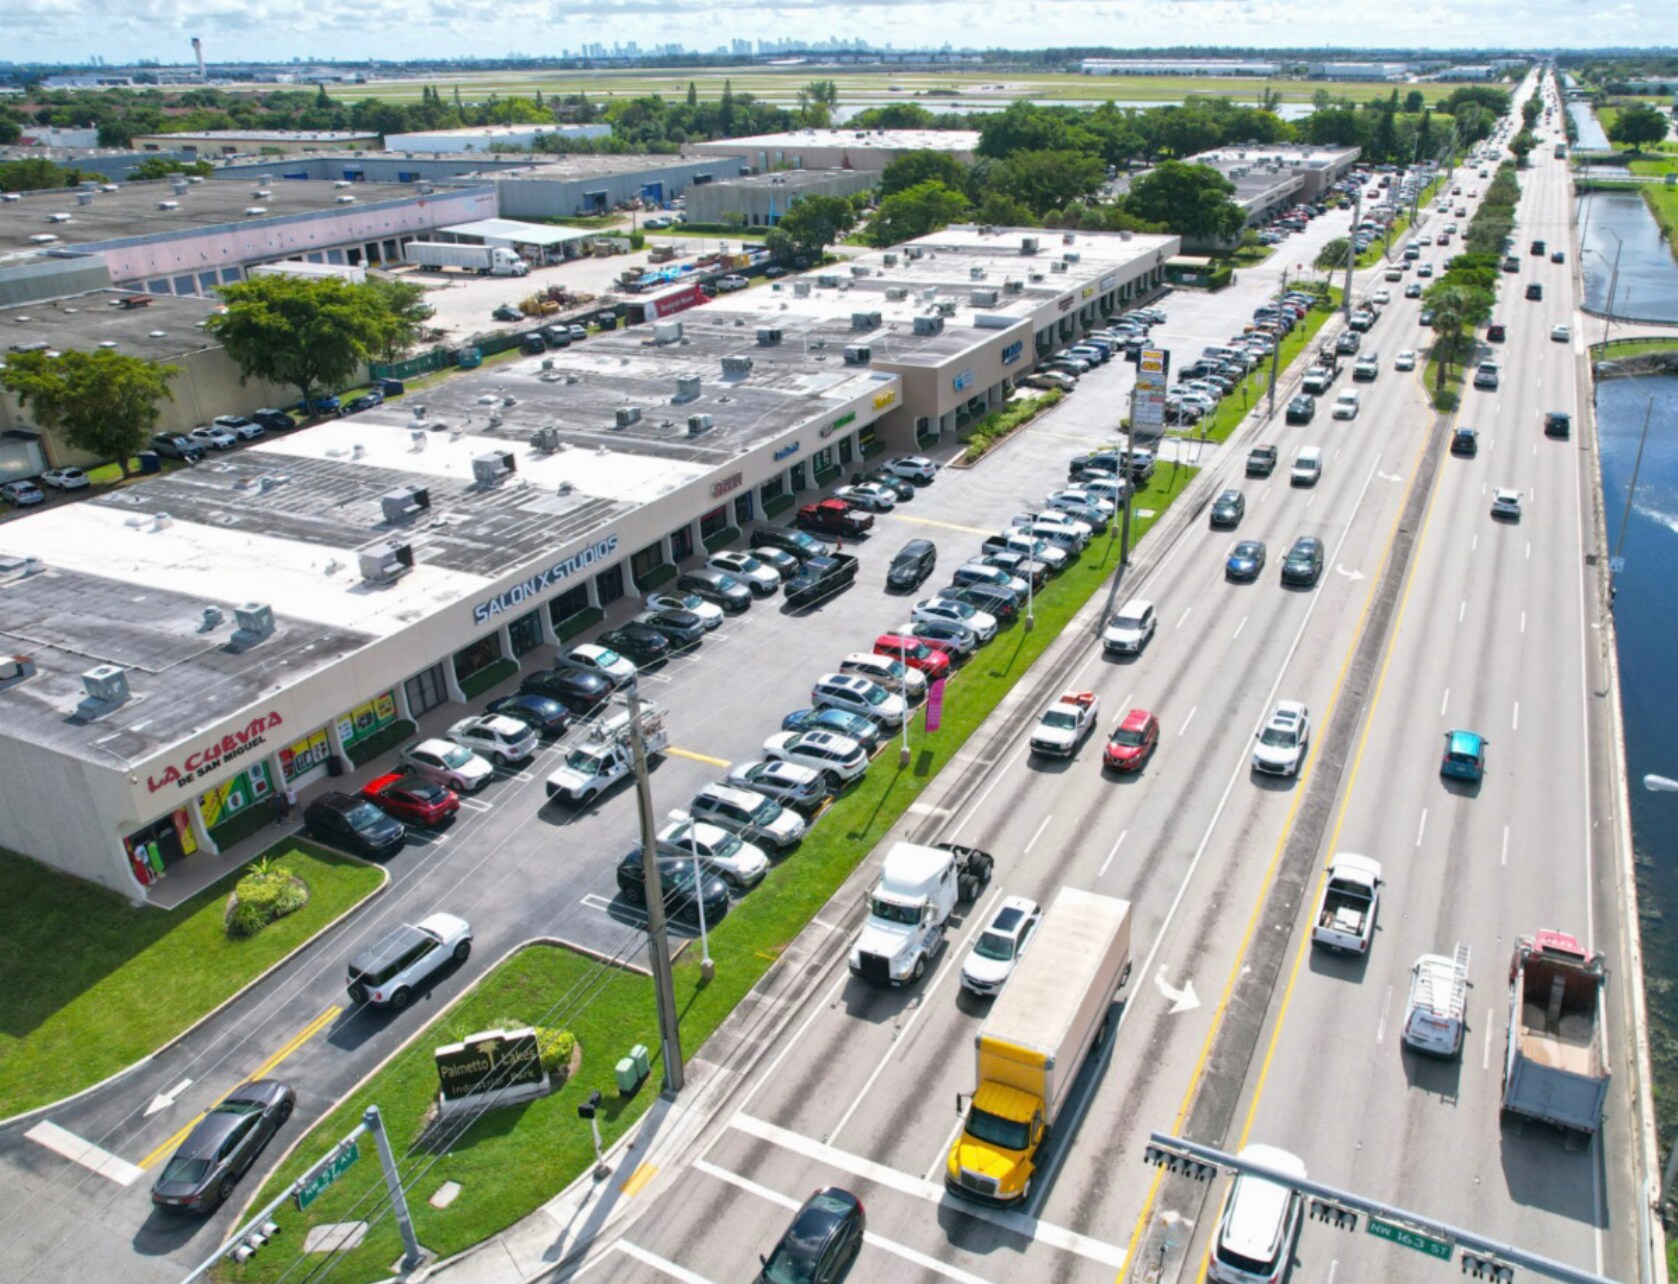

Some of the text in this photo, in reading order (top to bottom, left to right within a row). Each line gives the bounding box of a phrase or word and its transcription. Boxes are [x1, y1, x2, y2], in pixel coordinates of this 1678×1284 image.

[474, 535, 619, 625] SALON X STUDIOS
[147, 766, 181, 793] LA
[184, 711, 282, 772] CUEVITA
[177, 735, 266, 788] DE SAN MIGUEL
[440, 1049, 535, 1079] Palmetto Lakes
[511, 1070, 535, 1080] Park
[322, 1162, 336, 1180] 57
[1370, 1223, 1449, 1256] NW 163 ST
